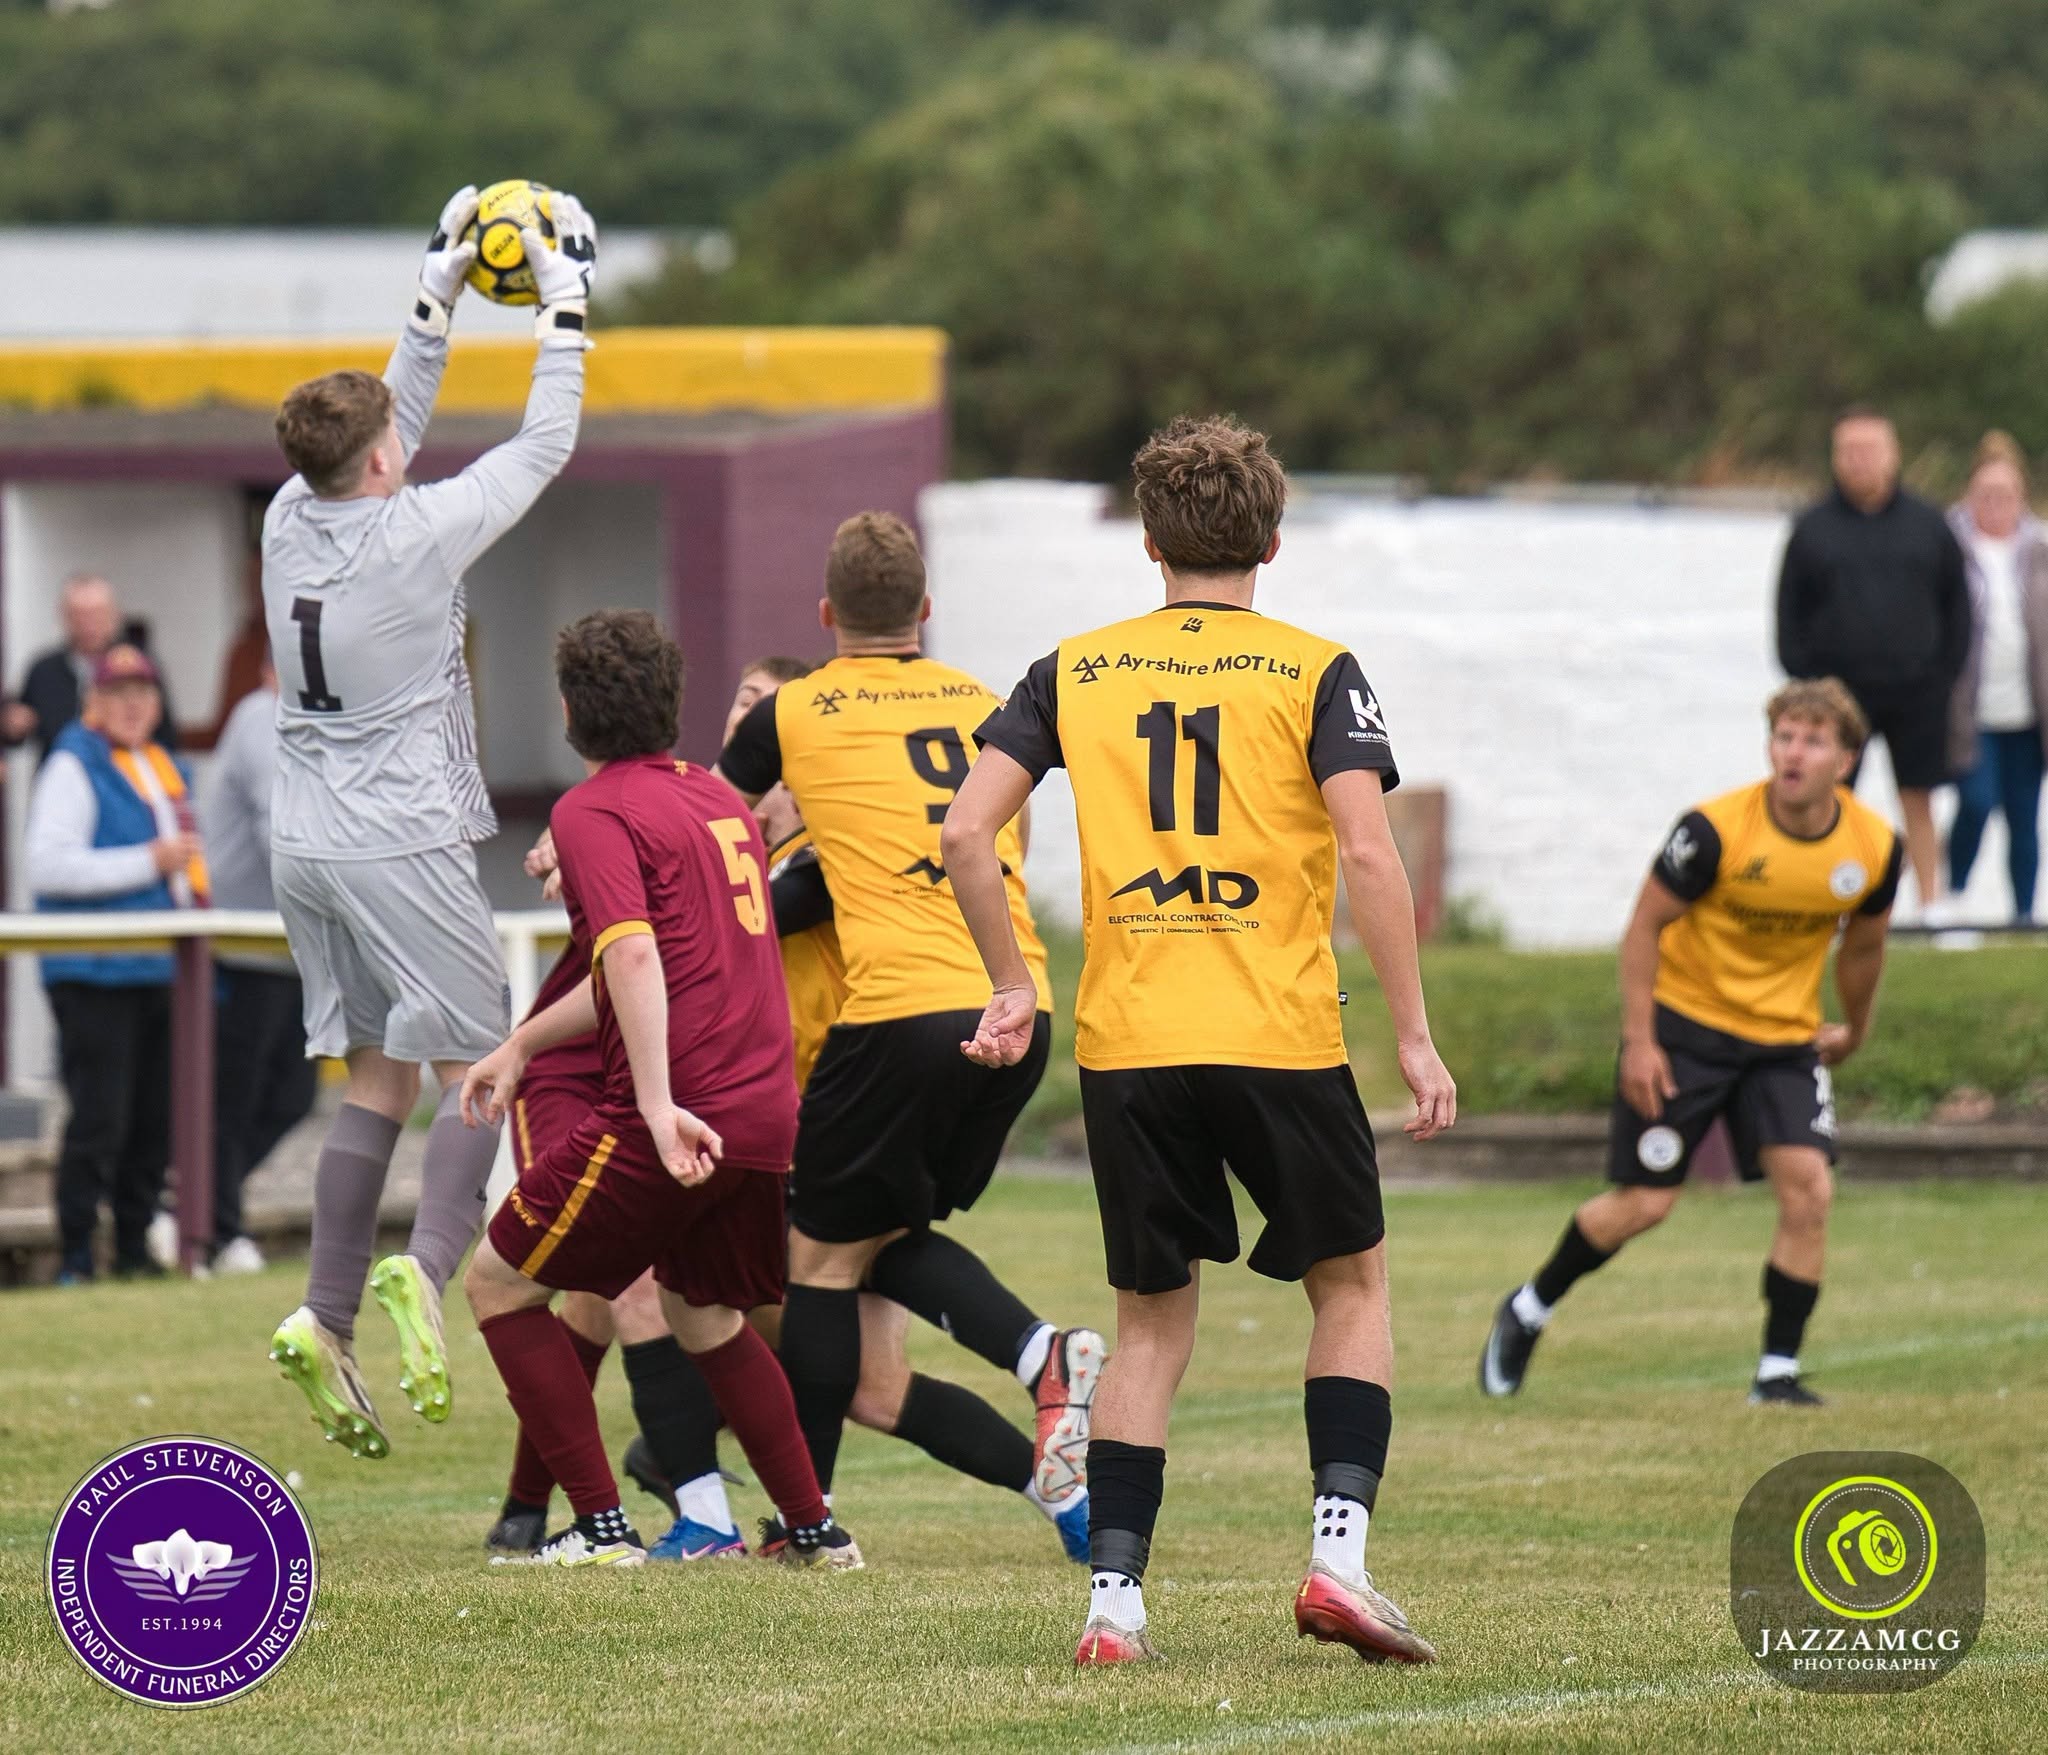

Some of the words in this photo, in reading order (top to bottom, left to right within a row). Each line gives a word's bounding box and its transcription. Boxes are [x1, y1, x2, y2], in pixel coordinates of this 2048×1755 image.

[289, 597, 342, 712] 1
[1115, 652, 1208, 676] Ayrshire
[1212, 654, 1265, 674] MOT
[1267, 658, 1301, 681] Ltd
[856, 687, 937, 704] Ayrshire
[940, 683, 982, 698] MOT
[905, 726, 970, 825] 9
[1136, 701, 1220, 836] 11
[706, 817, 767, 936] 5
[1108, 865, 1260, 909] MD
[1108, 913, 1168, 924] ELECTRICAL
[1240, 920, 1260, 929] LTD
